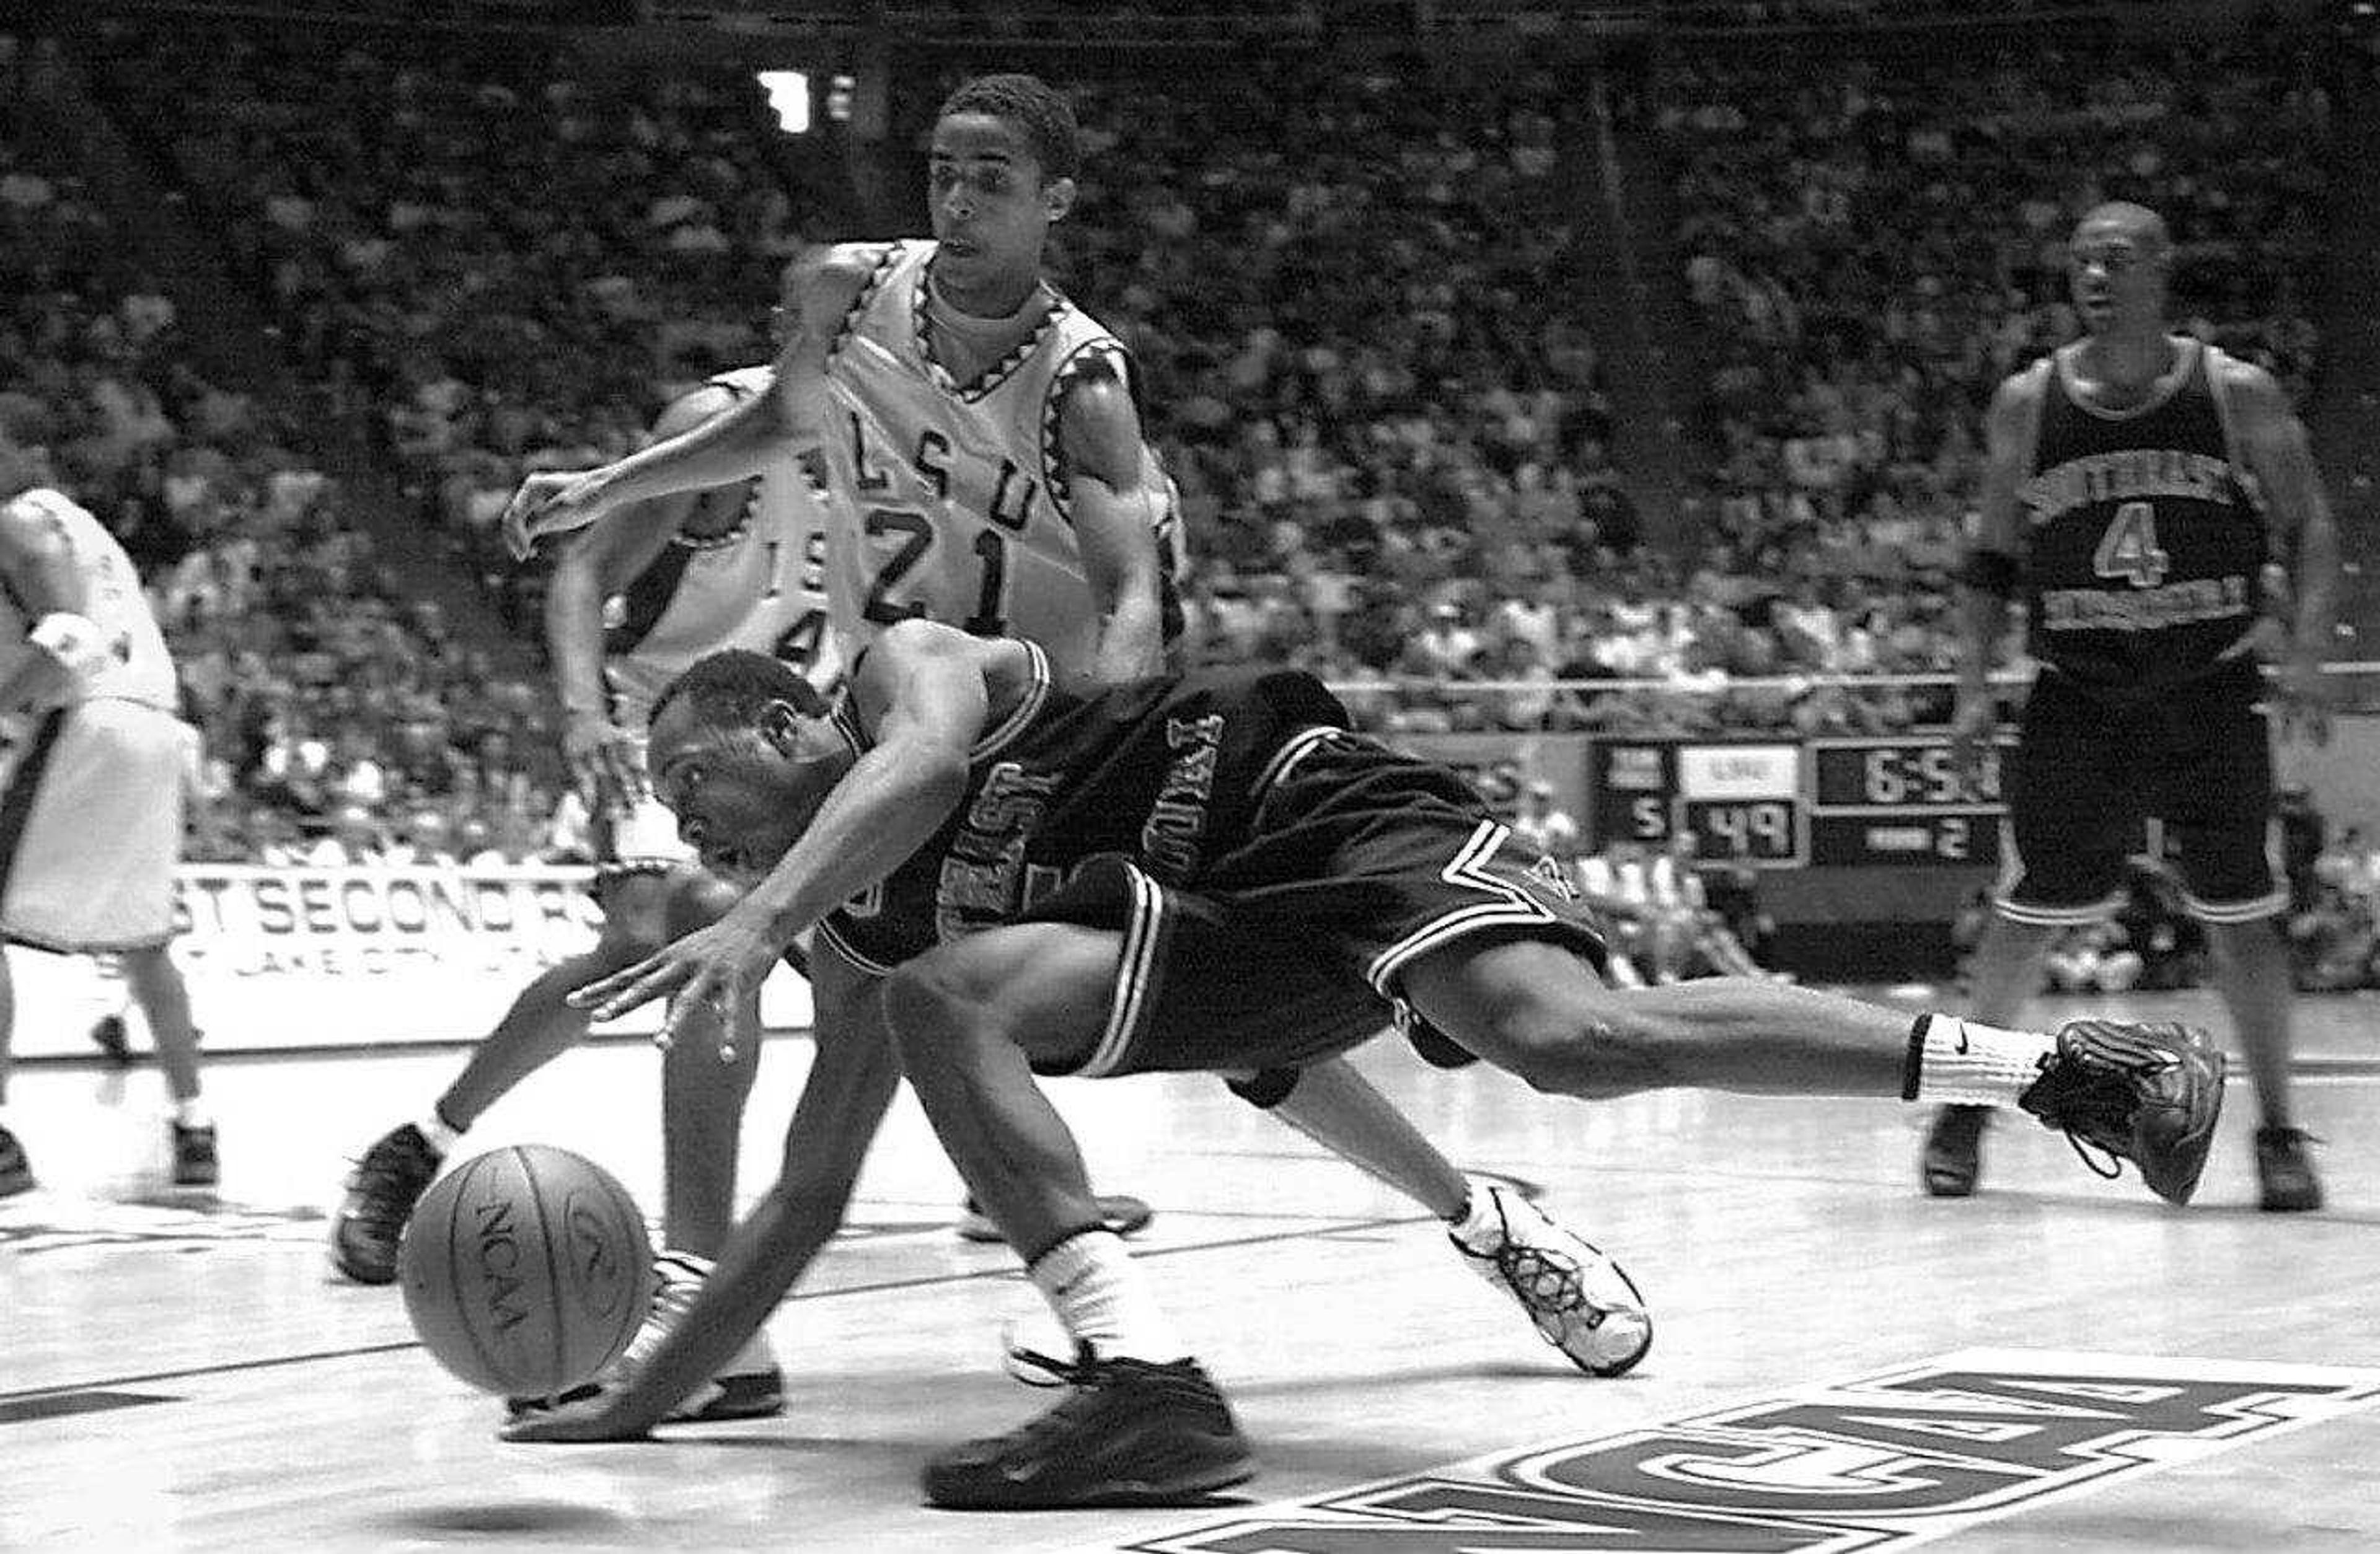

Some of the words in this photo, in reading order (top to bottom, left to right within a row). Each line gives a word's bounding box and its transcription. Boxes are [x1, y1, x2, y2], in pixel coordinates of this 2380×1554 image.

[850, 411, 1036, 532] LSU
[863, 508, 1009, 638] 21
[2092, 501, 2169, 589] 4
[1708, 807, 1789, 858] 49
[1935, 819, 1970, 858] 2
[253, 877, 514, 934] SECOND
[475, 1200, 531, 1333] NCAA
[1123, 1369, 2355, 1554] NCAA
